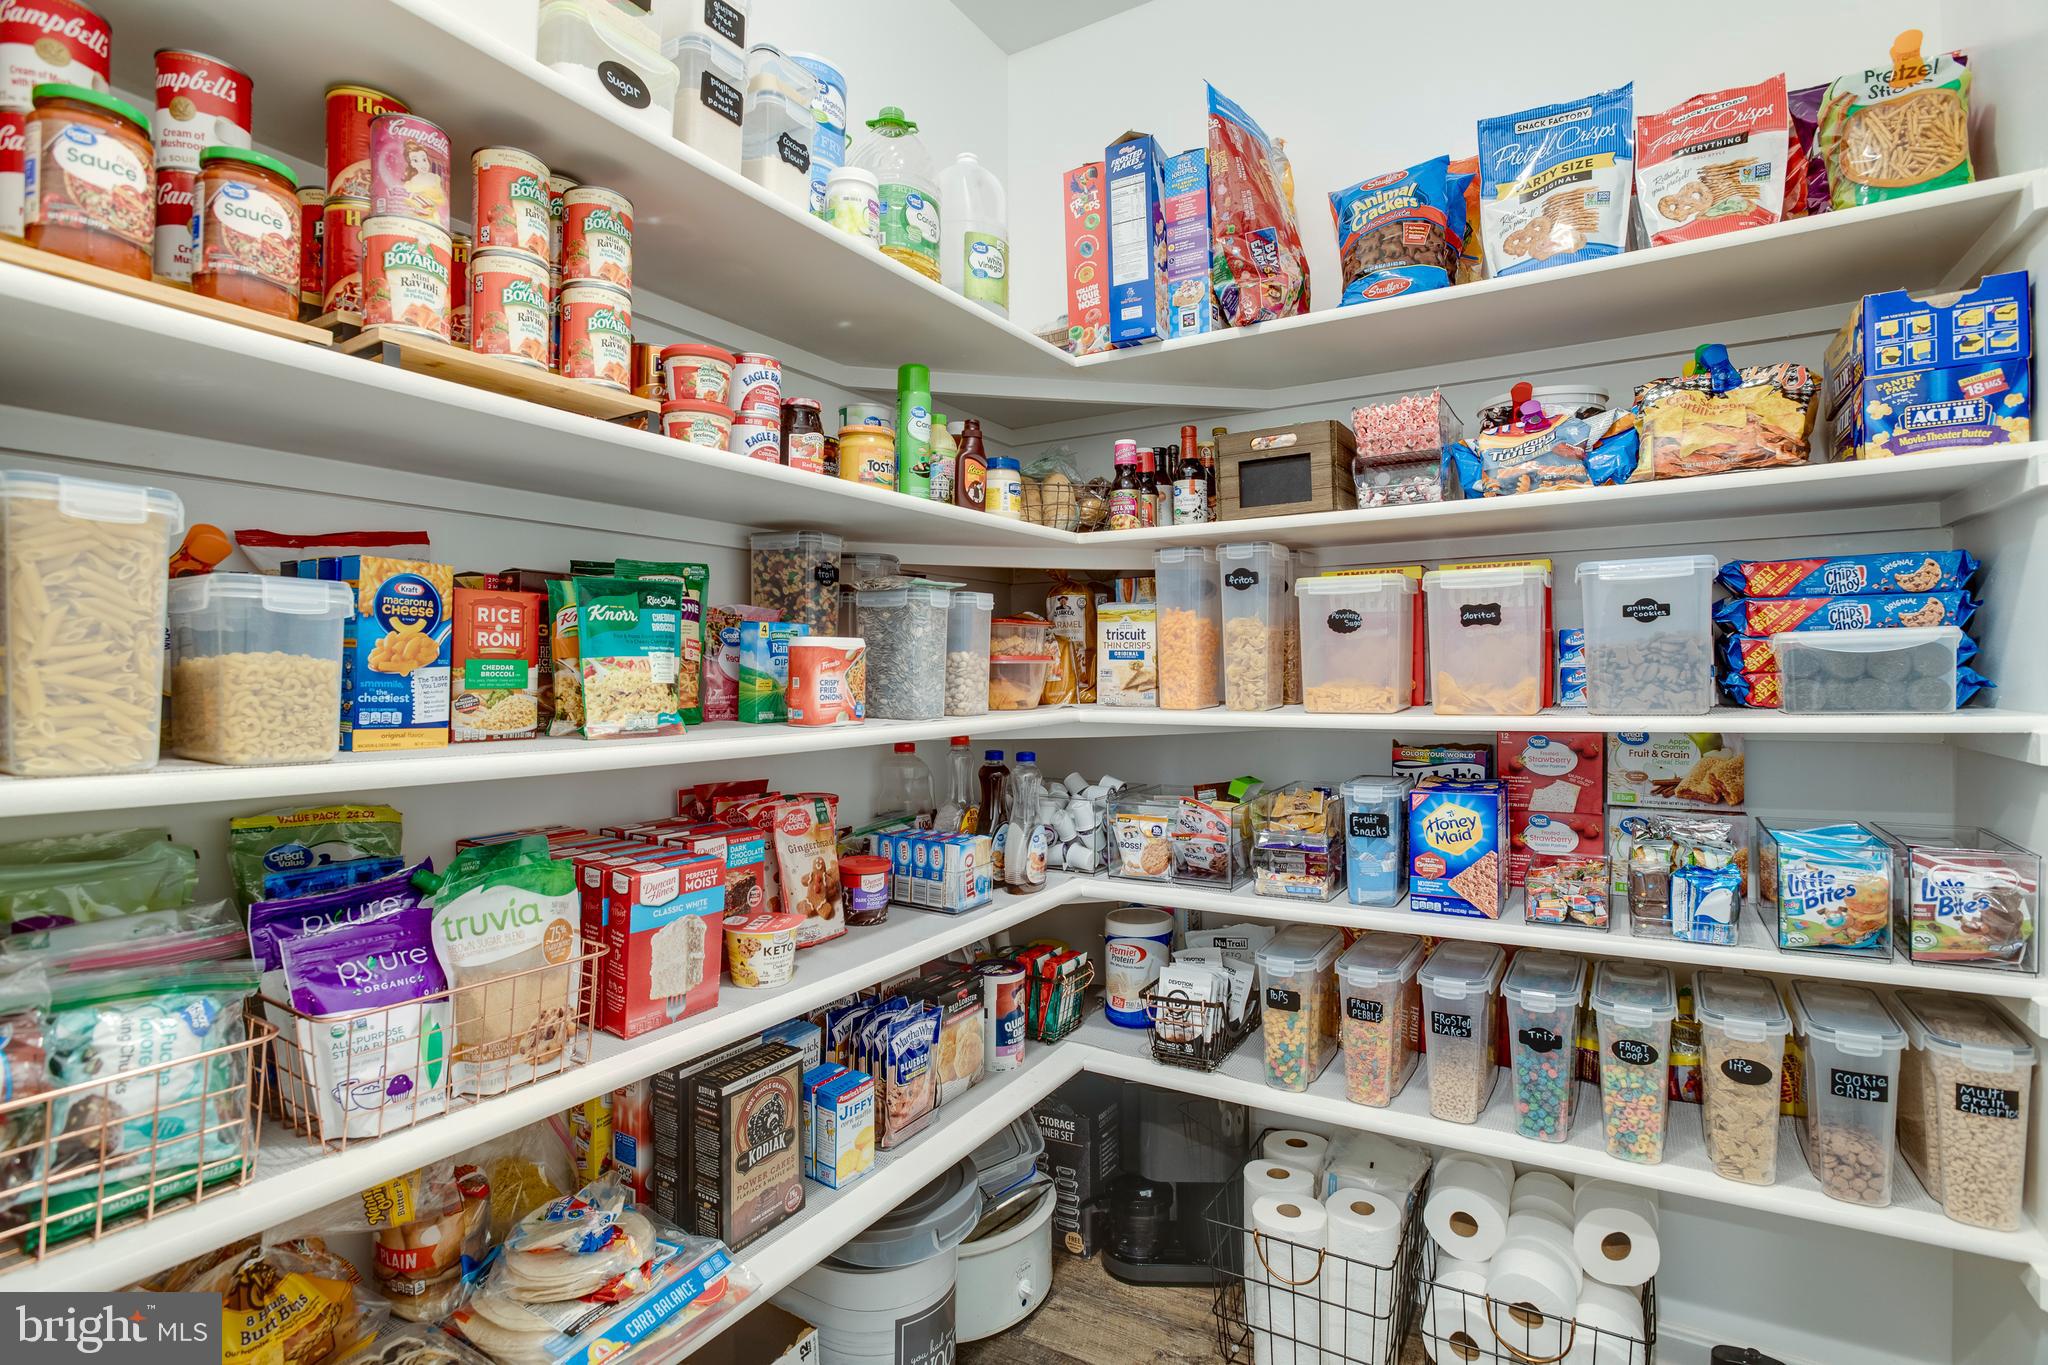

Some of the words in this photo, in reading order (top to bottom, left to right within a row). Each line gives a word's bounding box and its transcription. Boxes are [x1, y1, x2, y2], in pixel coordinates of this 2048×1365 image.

[713, 0, 739, 22] gluten
[714, 12, 732, 28] free
[712, 19, 736, 39] flour
[1863, 58, 1939, 86] Pretzel
[605, 71, 642, 98] Sugar
[1705, 96, 1745, 114] FACTORY
[1516, 119, 1546, 132] SNACK
[1548, 109, 1589, 126] FACTORY
[163, 129, 191, 139] Cream
[1556, 122, 1616, 152] Crisps
[1648, 121, 1710, 155] Pretzel
[1711, 103, 1774, 132] Crisps
[1677, 135, 1742, 157] EVERYTHING
[66, 147, 137, 182] Sauce
[783, 149, 804, 166] flour
[1111, 149, 1144, 168] FROSTED
[1113, 158, 1142, 173] FLAKES
[1171, 167, 1198, 180] KRISPIES
[1176, 162, 1192, 170] RICE
[1561, 158, 1594, 174] SIZE
[1532, 175, 1579, 198] ORIGINAL
[1352, 183, 1418, 214] Animal
[223, 202, 283, 231] Sauce
[1351, 196, 1418, 233] Crackers
[605, 235, 619, 244] Mini
[986, 256, 1003, 268] White
[412, 273, 430, 282] Mini
[401, 277, 439, 295] Ravioli
[1368, 280, 1409, 297] Stauffer's
[1076, 290, 1101, 302] YOUR
[1078, 298, 1101, 310] NOSE
[742, 370, 770, 387] EAGLE
[1876, 373, 1921, 391] PANTRY
[1964, 383, 1984, 395] 18
[1984, 377, 2002, 390] BAGS
[1885, 382, 1917, 395] PACK
[1913, 406, 1951, 424] ACT
[1953, 404, 1976, 420] II
[745, 432, 771, 448] EAGLE
[1899, 434, 1927, 447] Movie
[1927, 429, 1962, 441] Theater
[1962, 430, 1992, 438] Butter
[1880, 559, 1914, 573] ORIGINAL
[817, 570, 835, 579] trail
[1228, 576, 1254, 584] fritos
[1825, 568, 1858, 586] Chips
[400, 585, 418, 593] Kraft
[383, 596, 428, 607] macaroni
[1627, 604, 1658, 613] animal
[1884, 599, 1918, 612] ORIGINAL
[477, 607, 520, 624] RICE
[588, 604, 636, 622] Knorr
[1462, 610, 1496, 620] doritos
[1749, 604, 1776, 626] PARTY
[1829, 607, 1862, 623] Chips
[477, 631, 520, 647] RONI
[1106, 628, 1146, 641] triscuit
[1103, 641, 1122, 649] THIN
[1123, 641, 1151, 649] CRISPS
[481, 664, 514, 672] CHEDDAR
[431, 675, 448, 683] Taste
[358, 692, 410, 703] cheesiest
[1528, 756, 1571, 765] Strawberry
[1629, 749, 1649, 758] Fruit
[1661, 750, 1690, 758] Grain
[278, 814, 311, 824] VALUE
[313, 811, 341, 820] PACK
[346, 811, 360, 820] 24
[361, 810, 375, 818] OZ
[1352, 816, 1379, 828] Fruit
[1426, 816, 1476, 833] Honey
[1353, 826, 1388, 837] Snacks
[1436, 828, 1472, 844] Maid
[1529, 835, 1572, 844] Strawberry
[730, 844, 747, 853] DARK
[730, 847, 764, 859] CHOCOLATE
[788, 837, 834, 854] Gingerbread
[1120, 842, 1142, 850] BOSS!
[269, 850, 305, 863] Great
[278, 858, 305, 867] Value
[1183, 853, 1208, 862] BOSS!
[686, 867, 718, 880] PERFECTLY
[643, 877, 676, 893] Duncan
[685, 875, 718, 891] MOIST
[1788, 870, 1835, 896] Little
[648, 887, 674, 902] Hines
[1804, 884, 1856, 909] Bites
[653, 904, 684, 918] CLASSIC
[686, 898, 708, 909] WHITE
[1938, 897, 1990, 916] Bites
[441, 898, 543, 942] truvía
[763, 942, 793, 956] KETO
[1109, 944, 1138, 957] Premier
[1215, 939, 1226, 948] Nu
[1227, 939, 1247, 948] Trail
[1111, 955, 1135, 964] Protein
[335, 951, 428, 987] pyure
[364, 977, 416, 994] ORGANIC
[1168, 979, 1193, 988] DEVOTION
[958, 993, 978, 1006] LOBSTER
[331, 1026, 405, 1051] ALL-PURPOSE
[896, 1032, 920, 1053] Martha
[1527, 1030, 1556, 1041] Trix
[331, 1046, 370, 1060] STEVIA
[1619, 1041, 1649, 1052] FROOT
[718, 1063, 750, 1081] TASTE
[751, 1047, 793, 1071] BETTER
[1728, 1059, 1753, 1074] life
[746, 1061, 787, 1084] PROTEIN-PACKED
[755, 1085, 772, 1098] WHOLE
[1960, 1085, 2004, 1099] Multi
[851, 1120, 862, 1129] mix
[1039, 1115, 1075, 1131] STORAGE
[1061, 1132, 1074, 1142] SET
[749, 1131, 787, 1168] KODIAK
[737, 1171, 769, 1194] POWER
[770, 1156, 796, 1174] CAKES
[161, 1181, 179, 1194] DIP
[108, 1192, 145, 1213] MOLD
[1066, 1235, 1082, 1244] FREE
[381, 1248, 417, 1269] PLAIN
[624, 1308, 656, 1338] CARB
[654, 1279, 697, 1318] BALANCE
